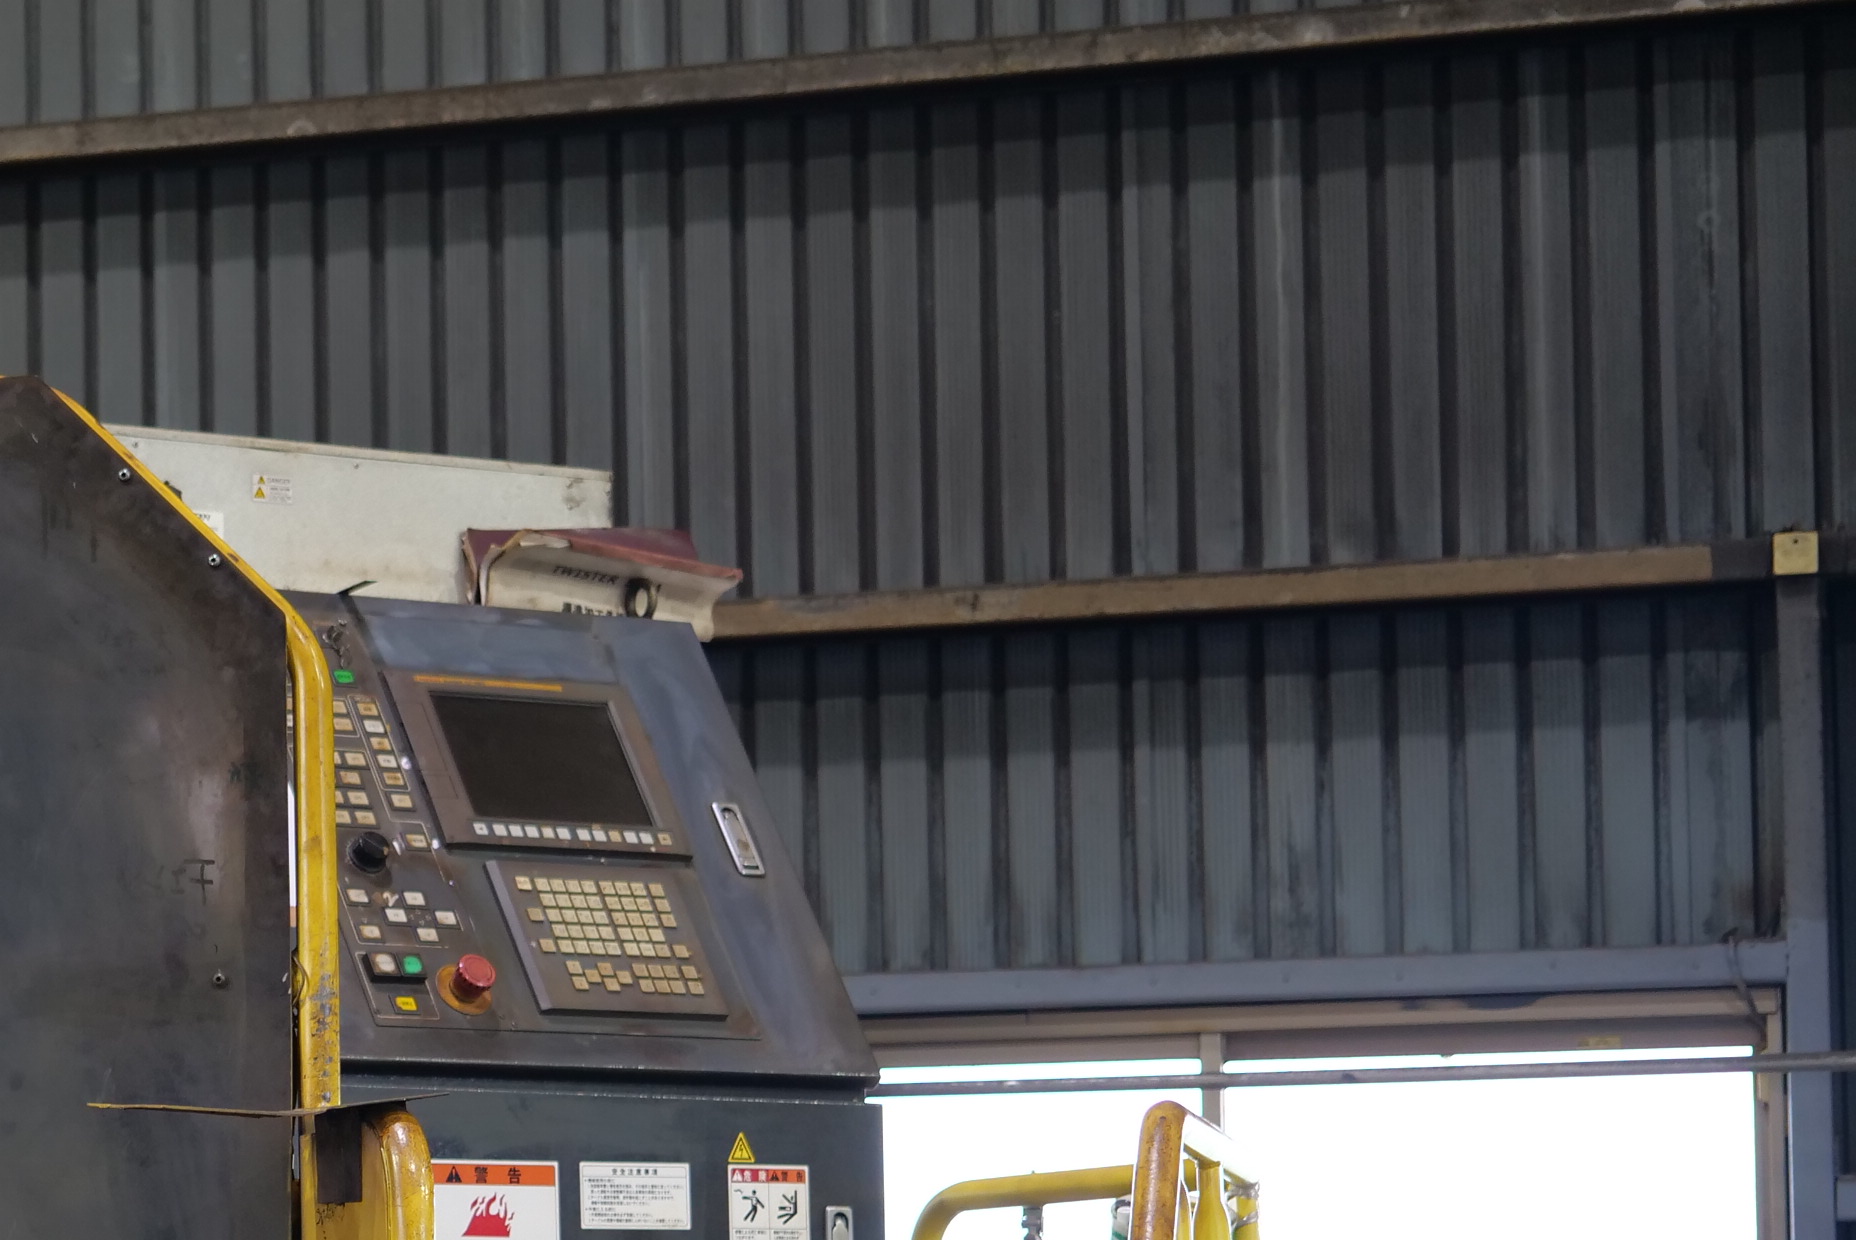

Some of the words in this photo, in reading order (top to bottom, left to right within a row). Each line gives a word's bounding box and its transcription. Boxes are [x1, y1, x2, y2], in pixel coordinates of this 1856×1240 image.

[552, 565, 619, 585] TWISTER
[474, 1166, 522, 1184] 警告
[743, 1170, 767, 1183] 危険
[781, 1171, 803, 1182] 警告
